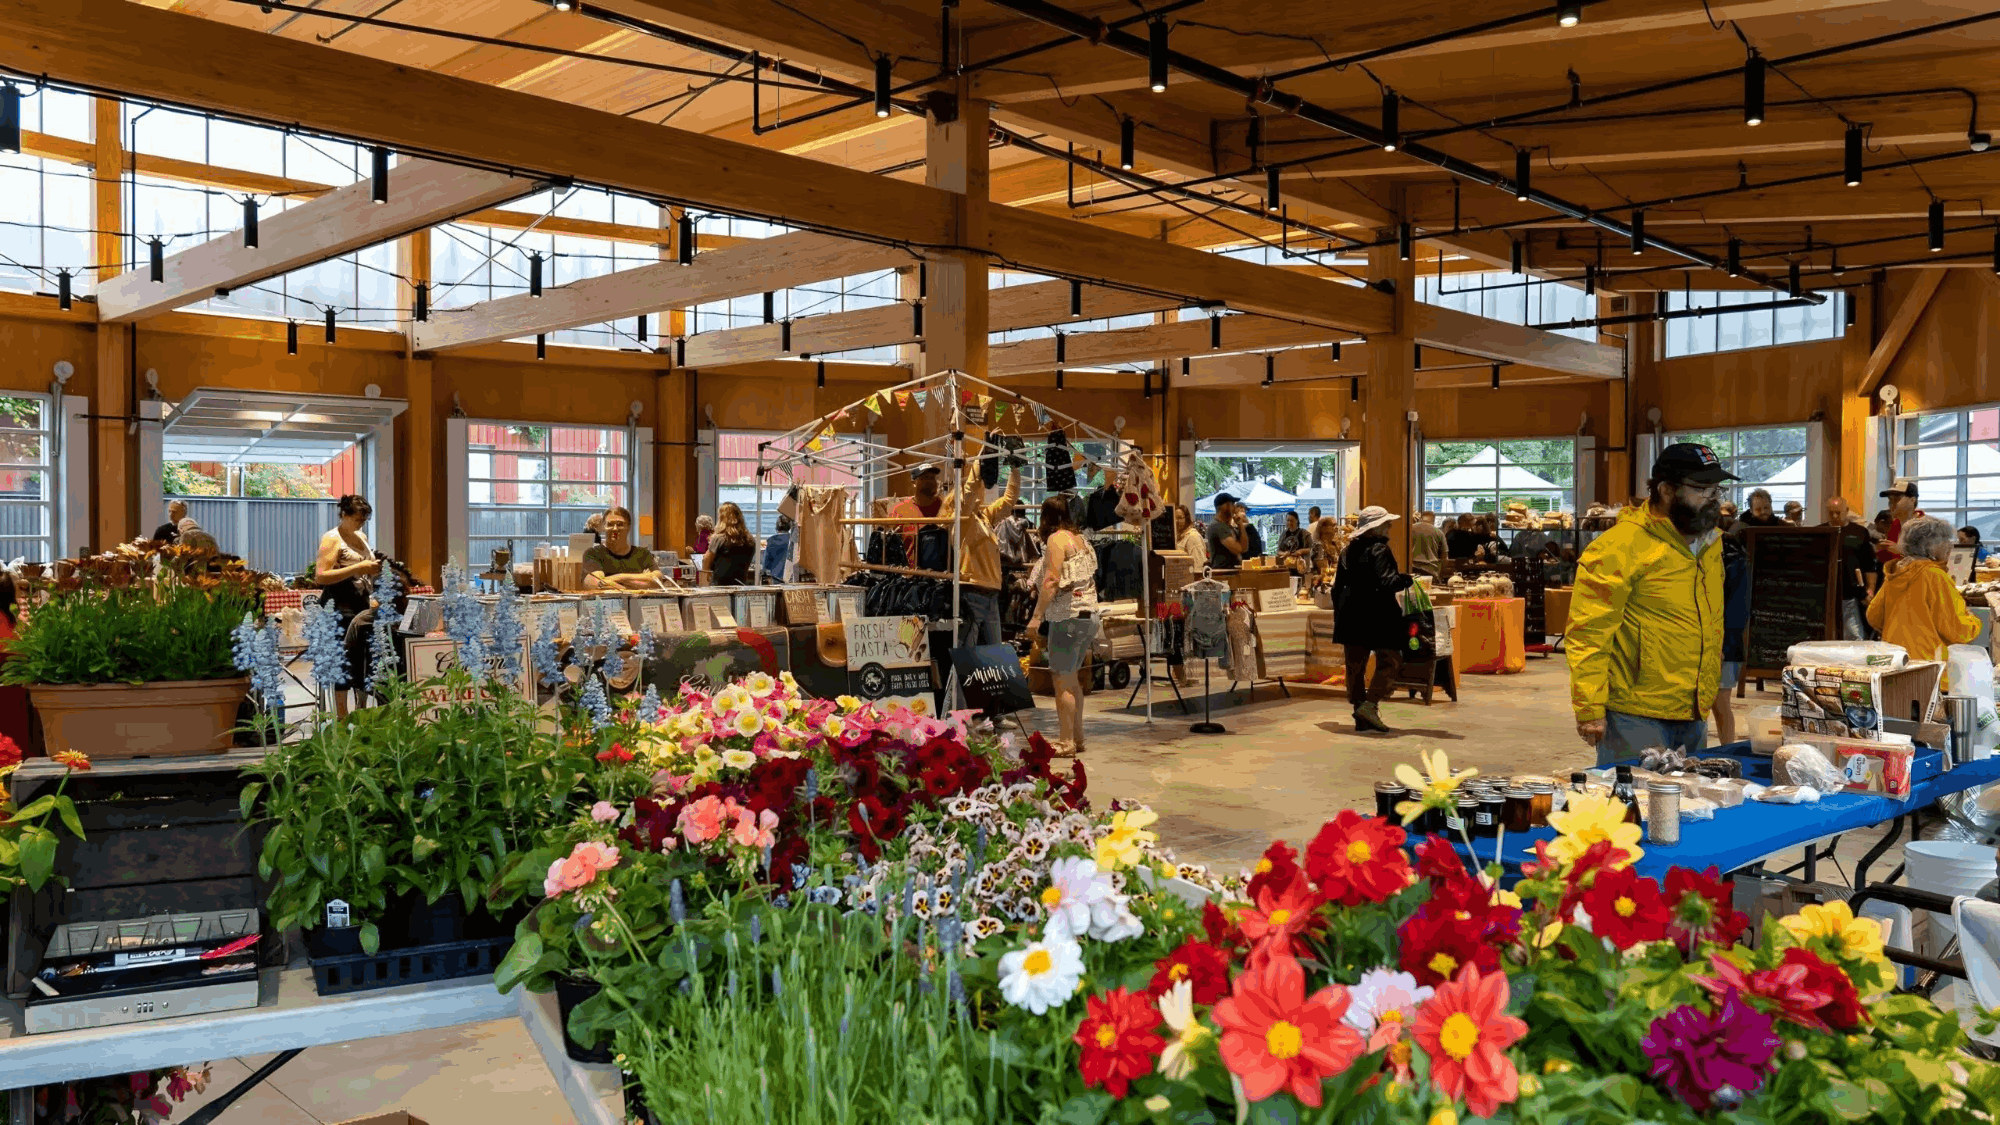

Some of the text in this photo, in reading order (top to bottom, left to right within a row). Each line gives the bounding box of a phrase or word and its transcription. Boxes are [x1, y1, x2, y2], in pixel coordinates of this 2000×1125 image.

[785, 590, 811, 604] CASH
[853, 623, 886, 640] FRESH
[854, 641, 889, 657] PASTA
